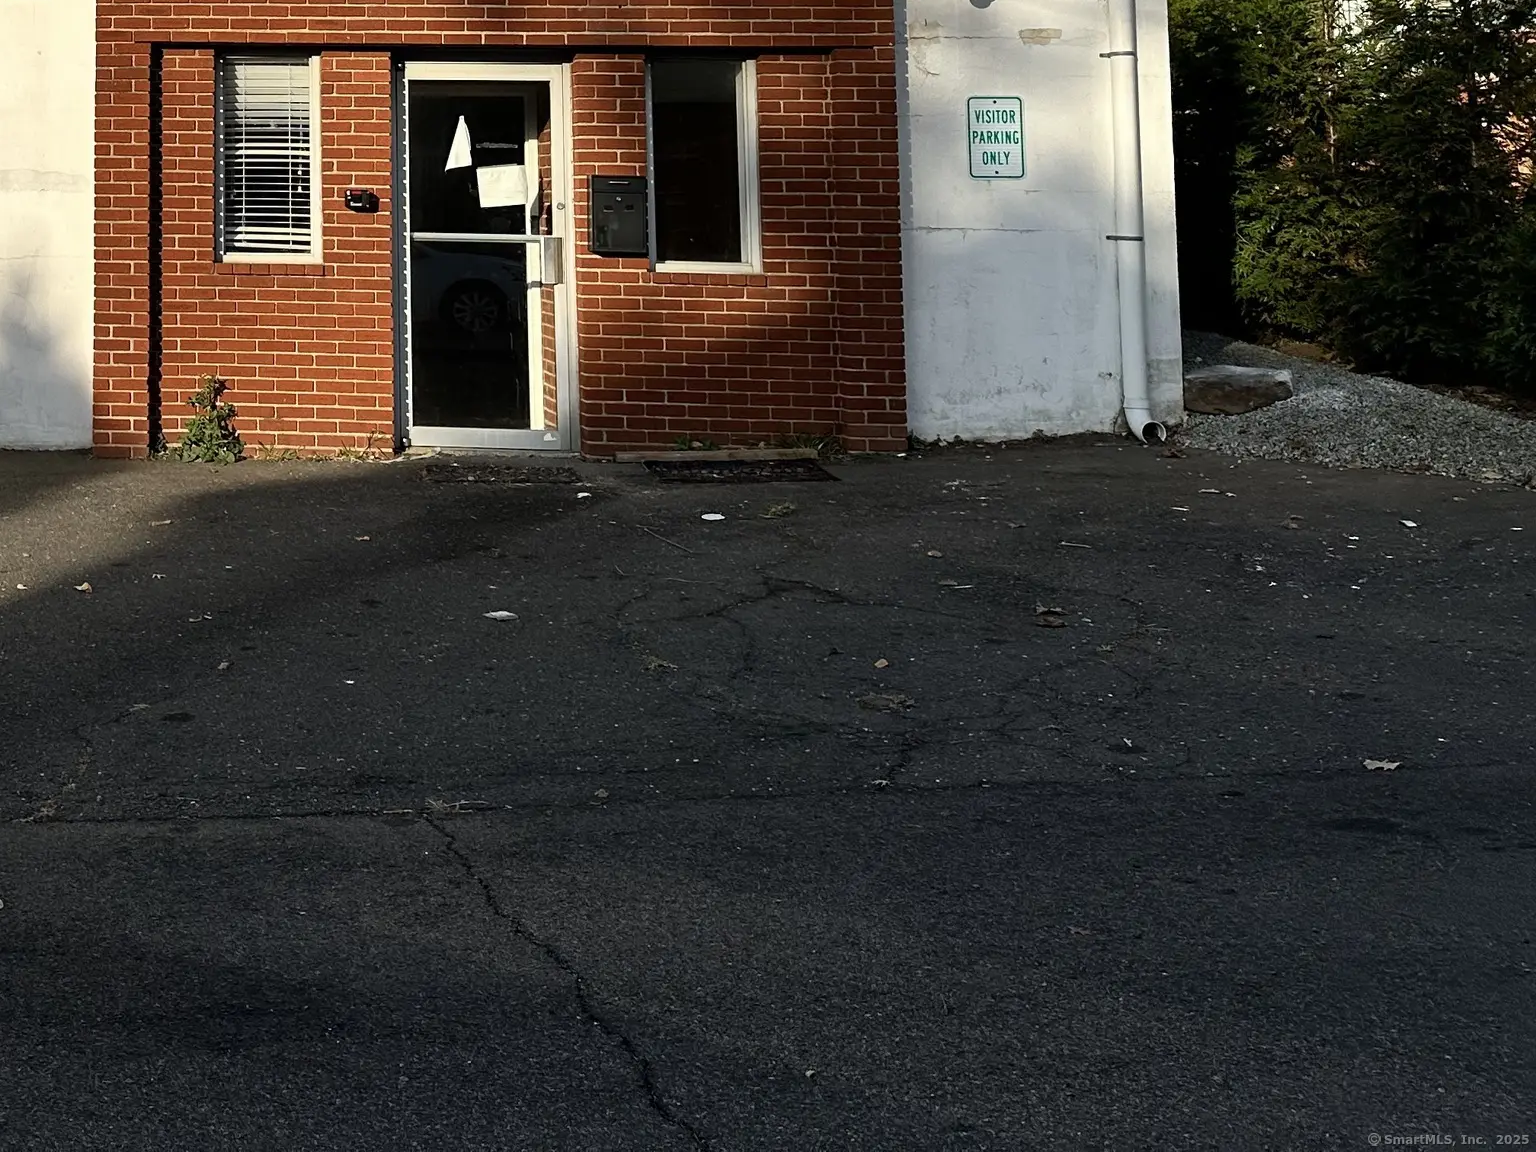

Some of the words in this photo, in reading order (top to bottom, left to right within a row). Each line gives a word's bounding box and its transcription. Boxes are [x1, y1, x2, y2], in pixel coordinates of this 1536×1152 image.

[974, 109, 1016, 124] VISITOR
[972, 130, 1020, 145] PARKING
[982, 151, 1011, 166] ONLY
